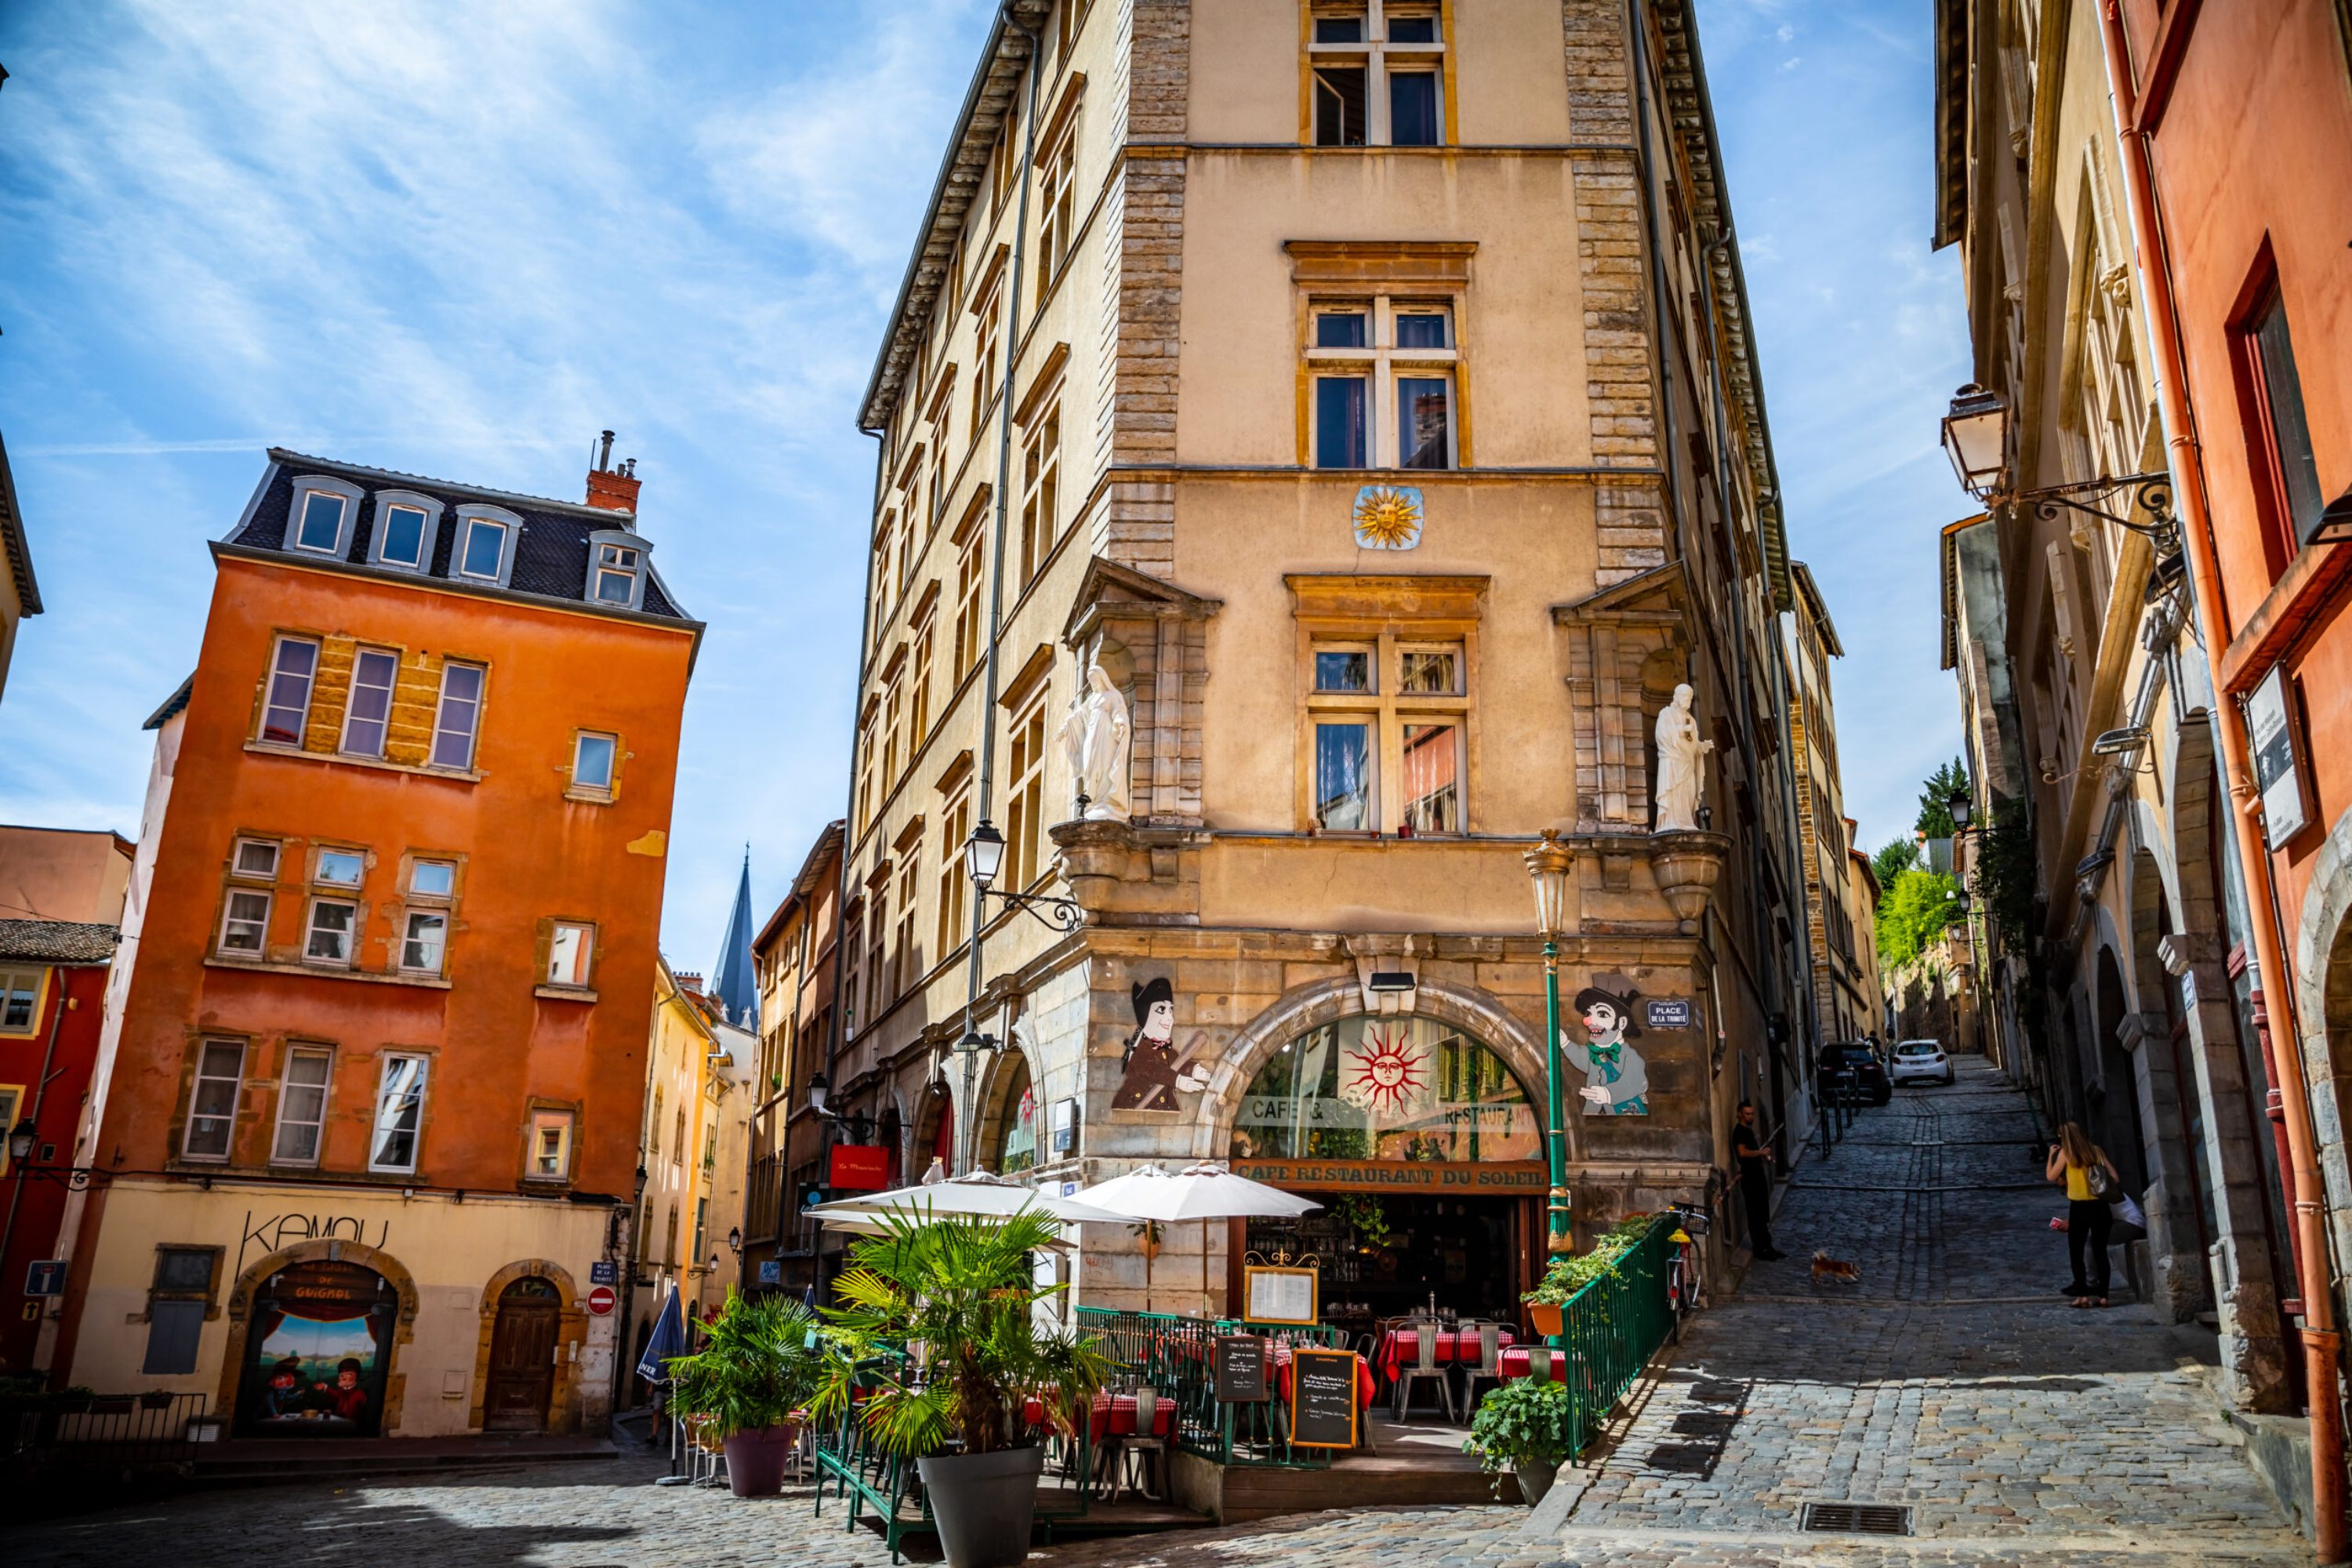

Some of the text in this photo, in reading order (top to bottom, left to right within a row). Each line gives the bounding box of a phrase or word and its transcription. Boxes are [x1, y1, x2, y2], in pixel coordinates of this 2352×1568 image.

[1310, 1102, 1324, 1120] &
[1444, 1106, 1532, 1127] RESTAURANT
[1296, 1167, 1433, 1184] RESTAURANT
[1442, 1171, 1470, 1185] DU
[1478, 1171, 1545, 1187] SOLEIL
